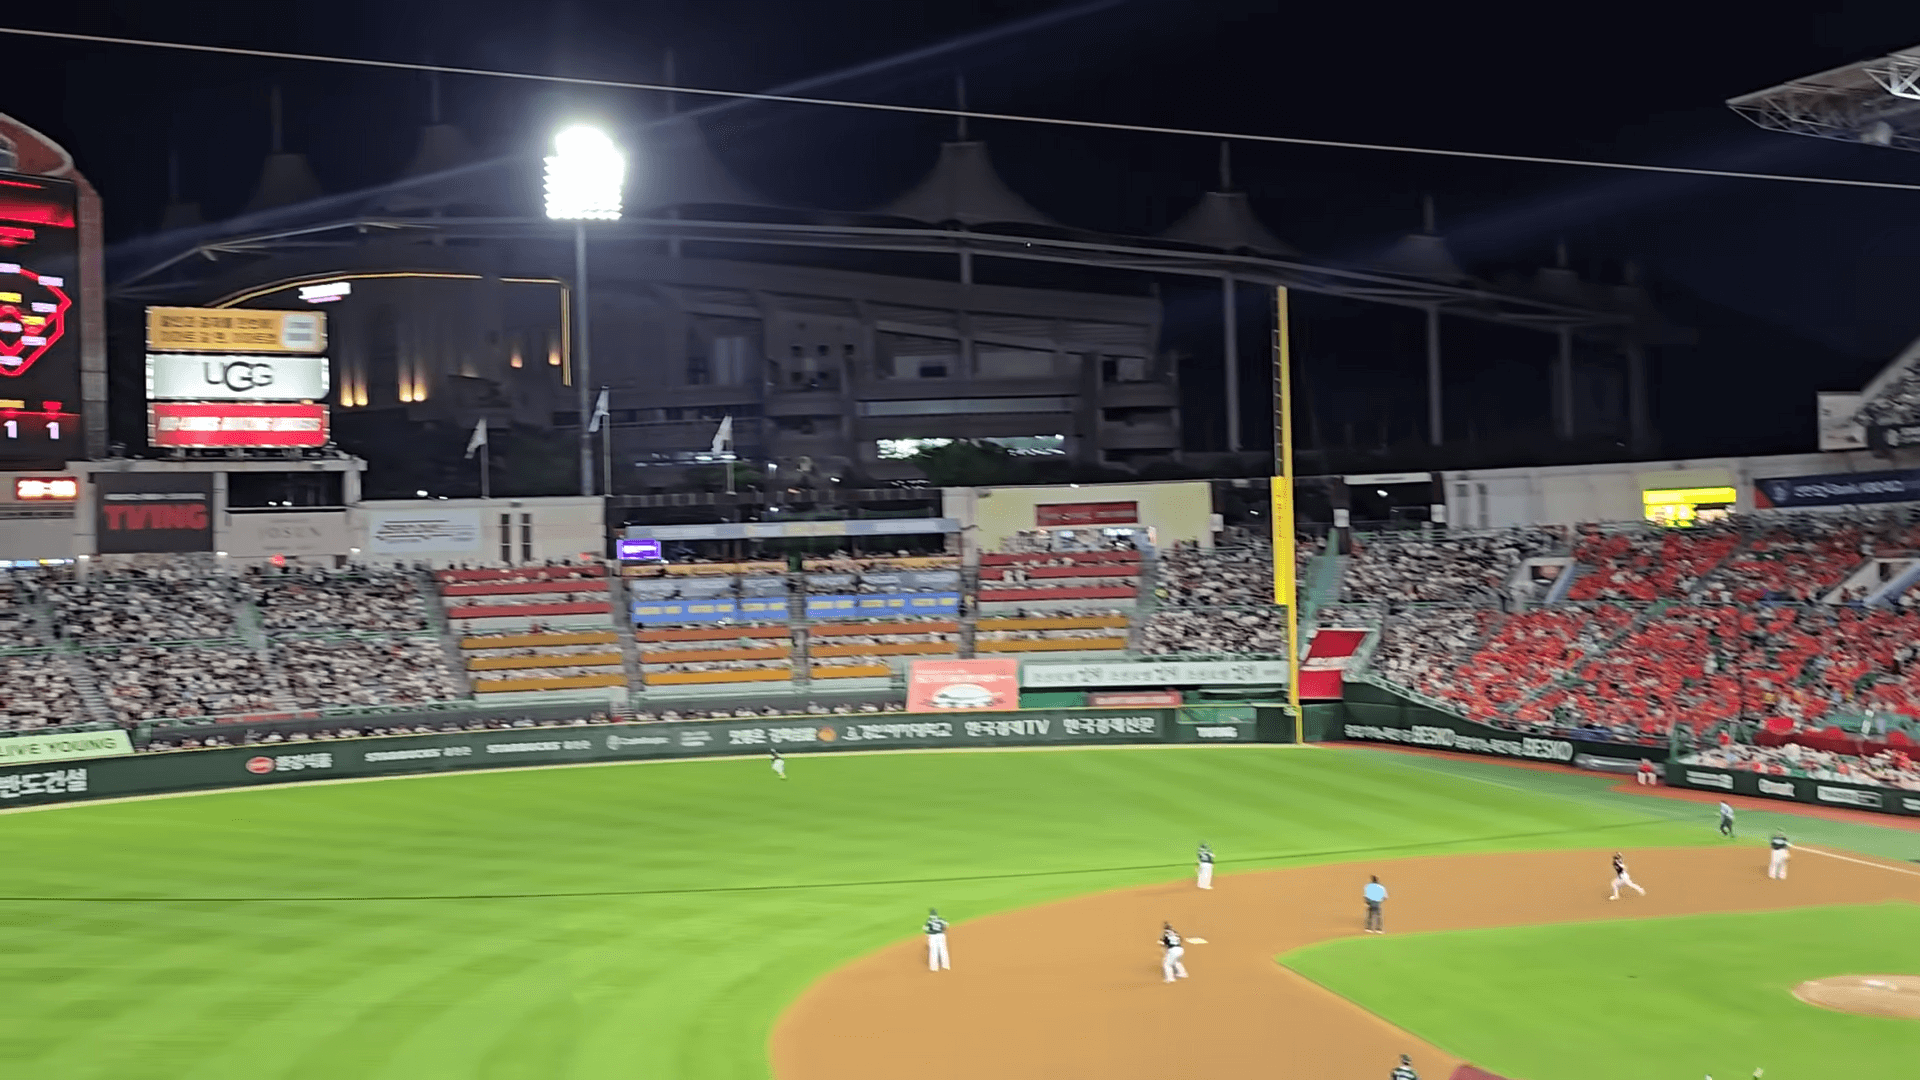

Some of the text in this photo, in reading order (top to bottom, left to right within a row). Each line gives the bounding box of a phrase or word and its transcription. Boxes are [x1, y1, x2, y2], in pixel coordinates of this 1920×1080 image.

[203, 361, 274, 392] UGG
[3, 420, 17, 439] 1
[46, 421, 60, 440] 1
[0, 768, 88, 799] 반도건설
